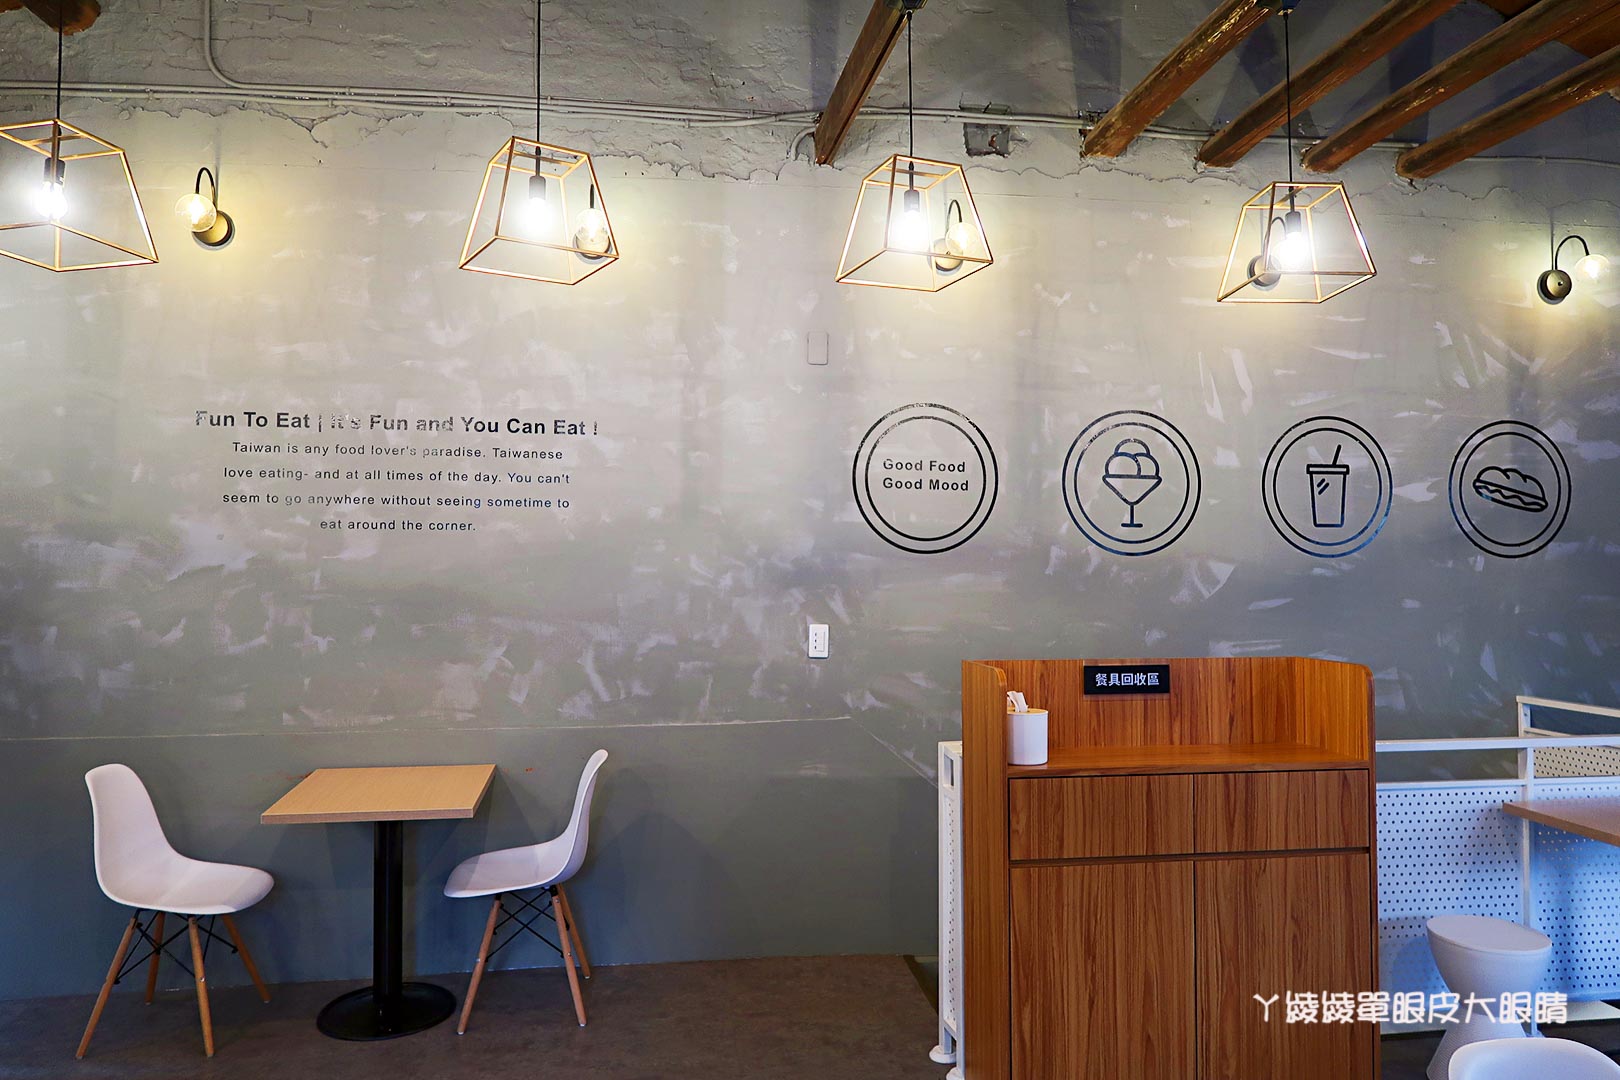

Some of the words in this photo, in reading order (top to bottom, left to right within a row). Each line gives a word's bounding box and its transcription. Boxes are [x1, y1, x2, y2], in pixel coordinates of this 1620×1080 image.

[195, 410, 235, 427] Fun
[243, 411, 268, 428] To
[276, 412, 310, 428] Eat
[369, 414, 408, 431] Fun
[415, 416, 454, 432] and
[460, 416, 499, 433] You
[506, 418, 545, 434] Can
[553, 419, 586, 436] Eat
[232, 441, 281, 453] Taiwan
[287, 443, 299, 454] is
[304, 444, 329, 457] any
[335, 444, 365, 455] food
[371, 445, 417, 456] lover's
[422, 446, 486, 459] paradise.
[492, 447, 563, 460] Taiwanese
[883, 458, 923, 471] Good
[929, 460, 966, 473] Food
[224, 467, 253, 478] love
[259, 468, 309, 481] eating-
[314, 469, 340, 480] and
[345, 470, 359, 480] at
[364, 470, 381, 480] all
[386, 470, 424, 481] times
[429, 471, 443, 481] of
[447, 471, 469, 482] the
[474, 472, 502, 485] day.
[507, 472, 532, 483] You
[537, 473, 570, 484] can't
[882, 477, 922, 490] Good
[929, 479, 969, 491] Mood
[222, 494, 260, 503] seem
[266, 494, 279, 504] to
[284, 495, 302, 506] go
[308, 495, 375, 507] anywhere
[380, 495, 431, 506] without
[436, 496, 481, 509] seeing
[487, 497, 552, 508] sometime
[557, 498, 570, 509] to
[320, 520, 342, 530] eat
[347, 520, 396, 530] around
[401, 520, 423, 531] the
[428, 521, 476, 531] corner.
[1095, 672, 1160, 687] 餐具回收區
